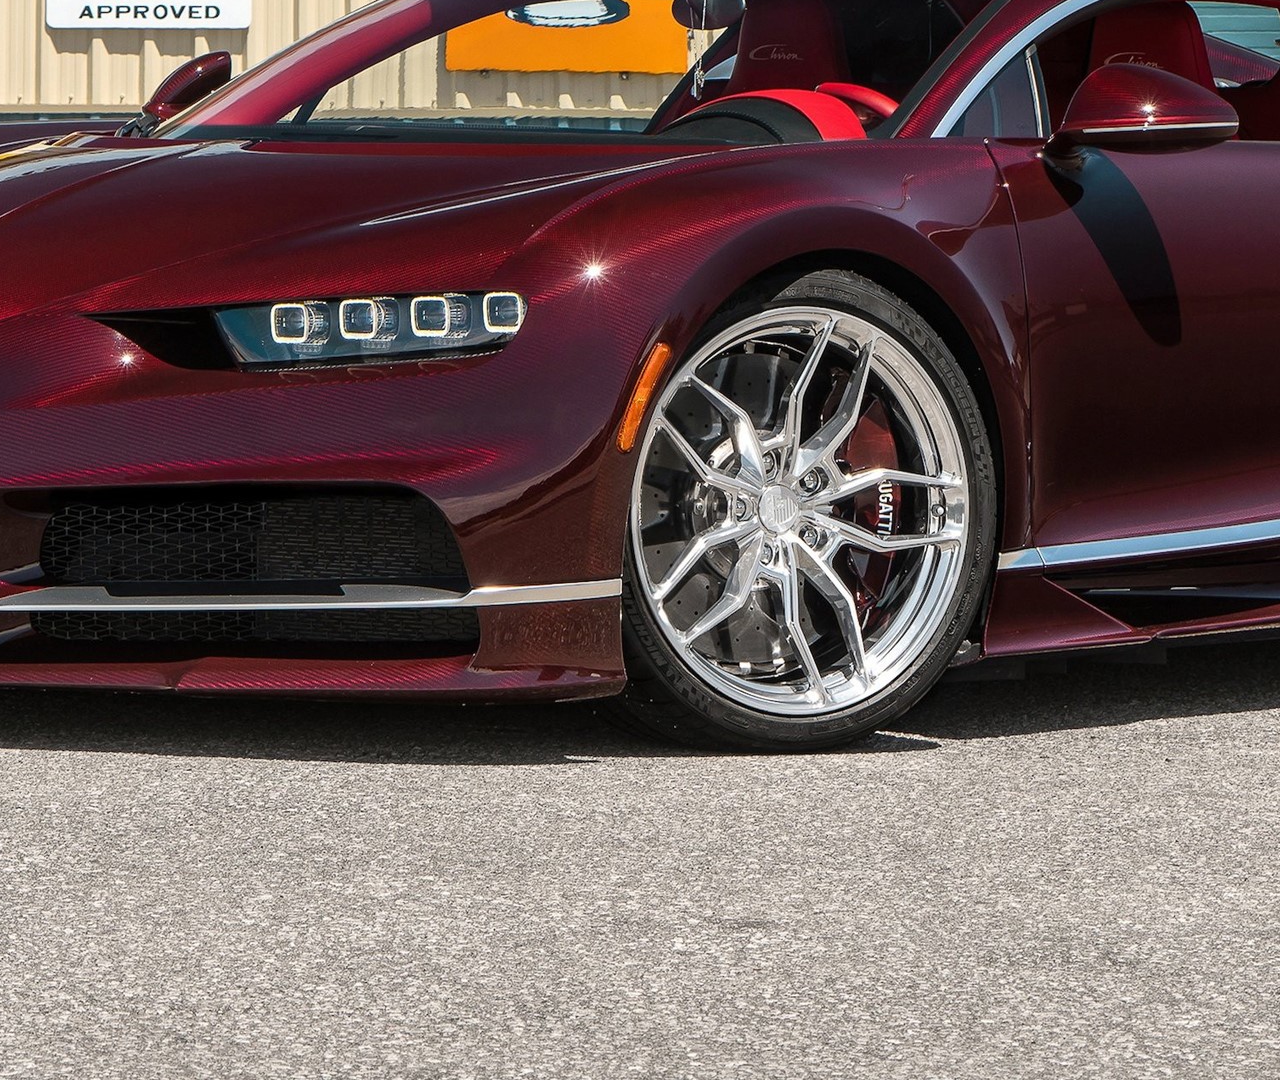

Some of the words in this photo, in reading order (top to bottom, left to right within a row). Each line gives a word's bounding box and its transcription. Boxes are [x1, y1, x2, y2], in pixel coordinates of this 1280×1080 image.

[78, 4, 221, 20] APPROVED
[749, 44, 803, 61] Chiron
[937, 357, 982, 437] MICHELIN
